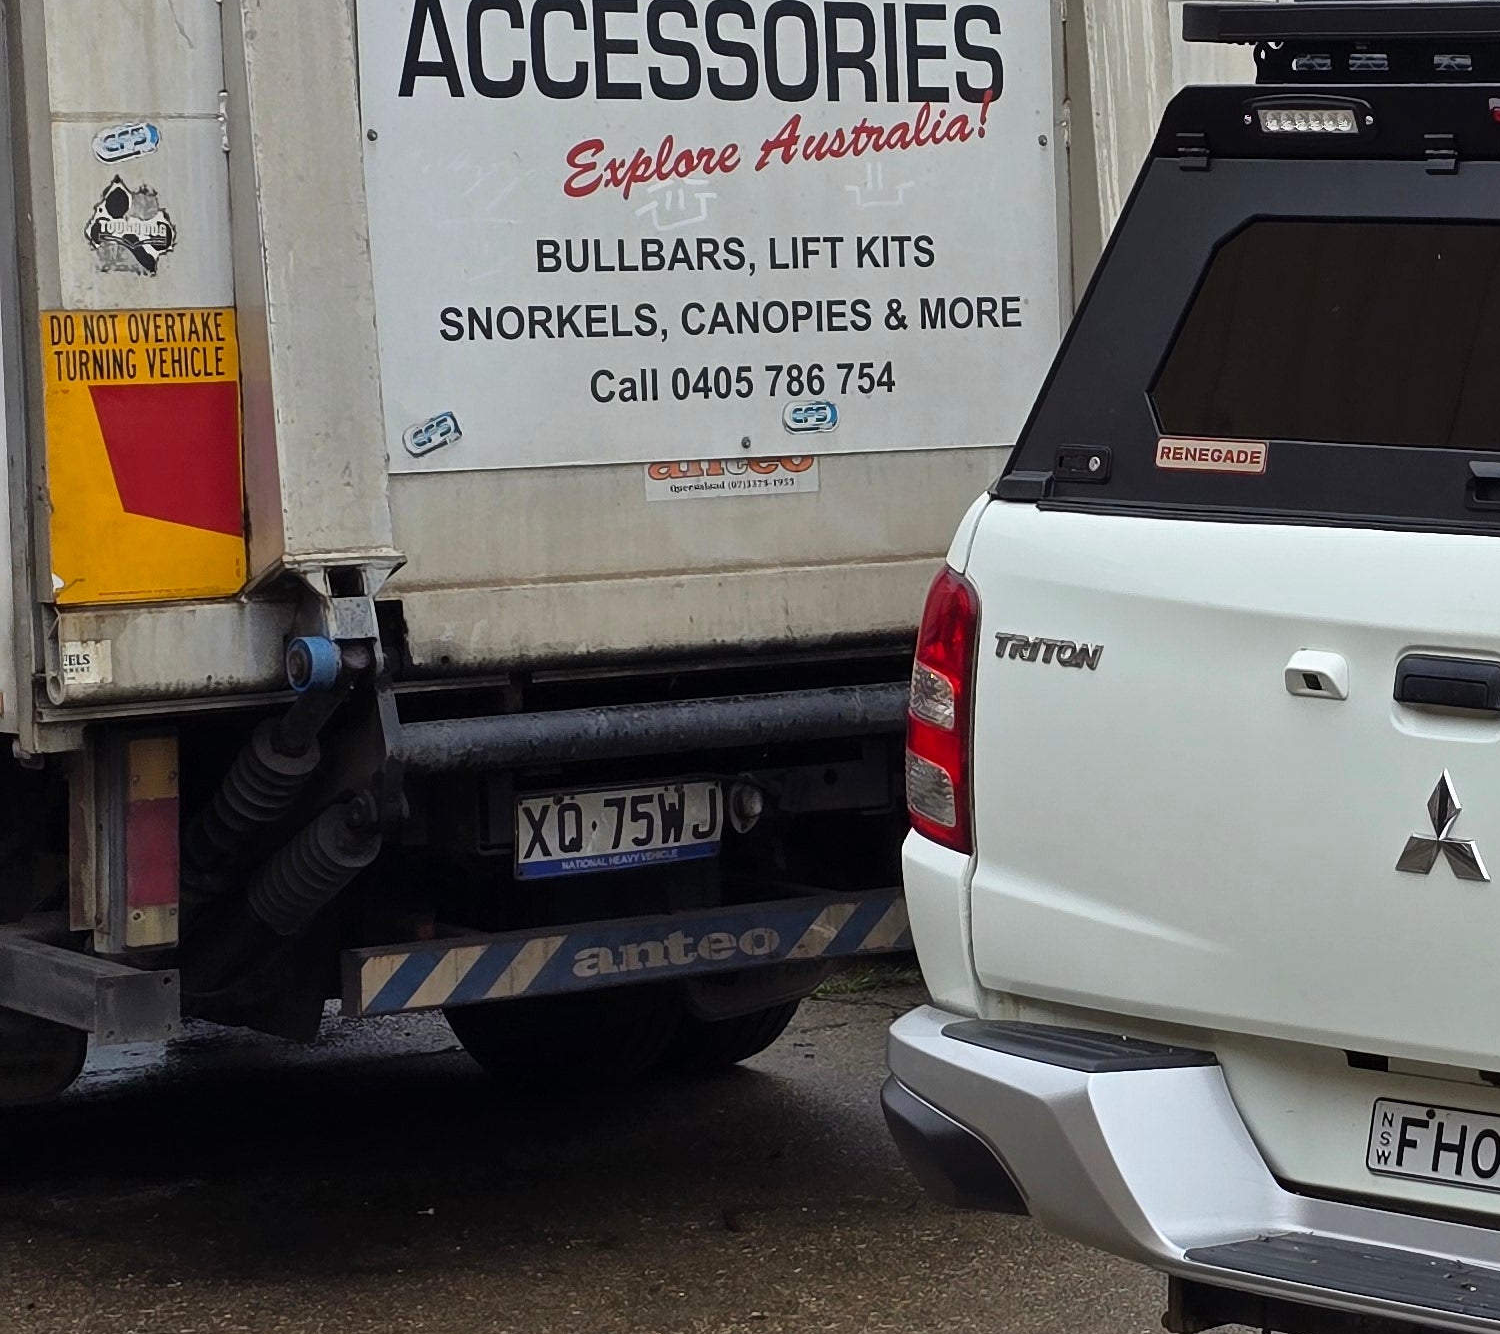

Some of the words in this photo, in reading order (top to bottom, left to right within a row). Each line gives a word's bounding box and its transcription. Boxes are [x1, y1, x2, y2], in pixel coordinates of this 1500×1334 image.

[563, 134, 741, 200] Explore
[755, 90, 993, 173] Australia!
[535, 237, 756, 277] BULLBARS,
[768, 237, 844, 271] LIFT
[855, 234, 936, 269] KITS
[50, 314, 75, 346] DO
[84, 314, 120, 346] NOT
[128, 312, 226, 344] OVERTAKE
[439, 302, 669, 343] SNORKELS,
[680, 299, 872, 337] CANOPIES
[884, 298, 909, 331] &
[919, 295, 1023, 330] MORE
[53, 347, 137, 382] TURNING
[146, 346, 226, 379] VEHICLE
[590, 367, 659, 404] Call
[671, 364, 754, 401] 0405
[764, 362, 825, 398] 786
[836, 360, 897, 395] 754
[1160, 446, 1262, 465] RENEGADE
[995, 632, 1105, 671] TRITON
[561, 857, 608, 870] NATIONAL
[608, 853, 640, 865] HEAVY
[640, 848, 679, 861] VEHICLE
[572, 925, 780, 979] anteo
